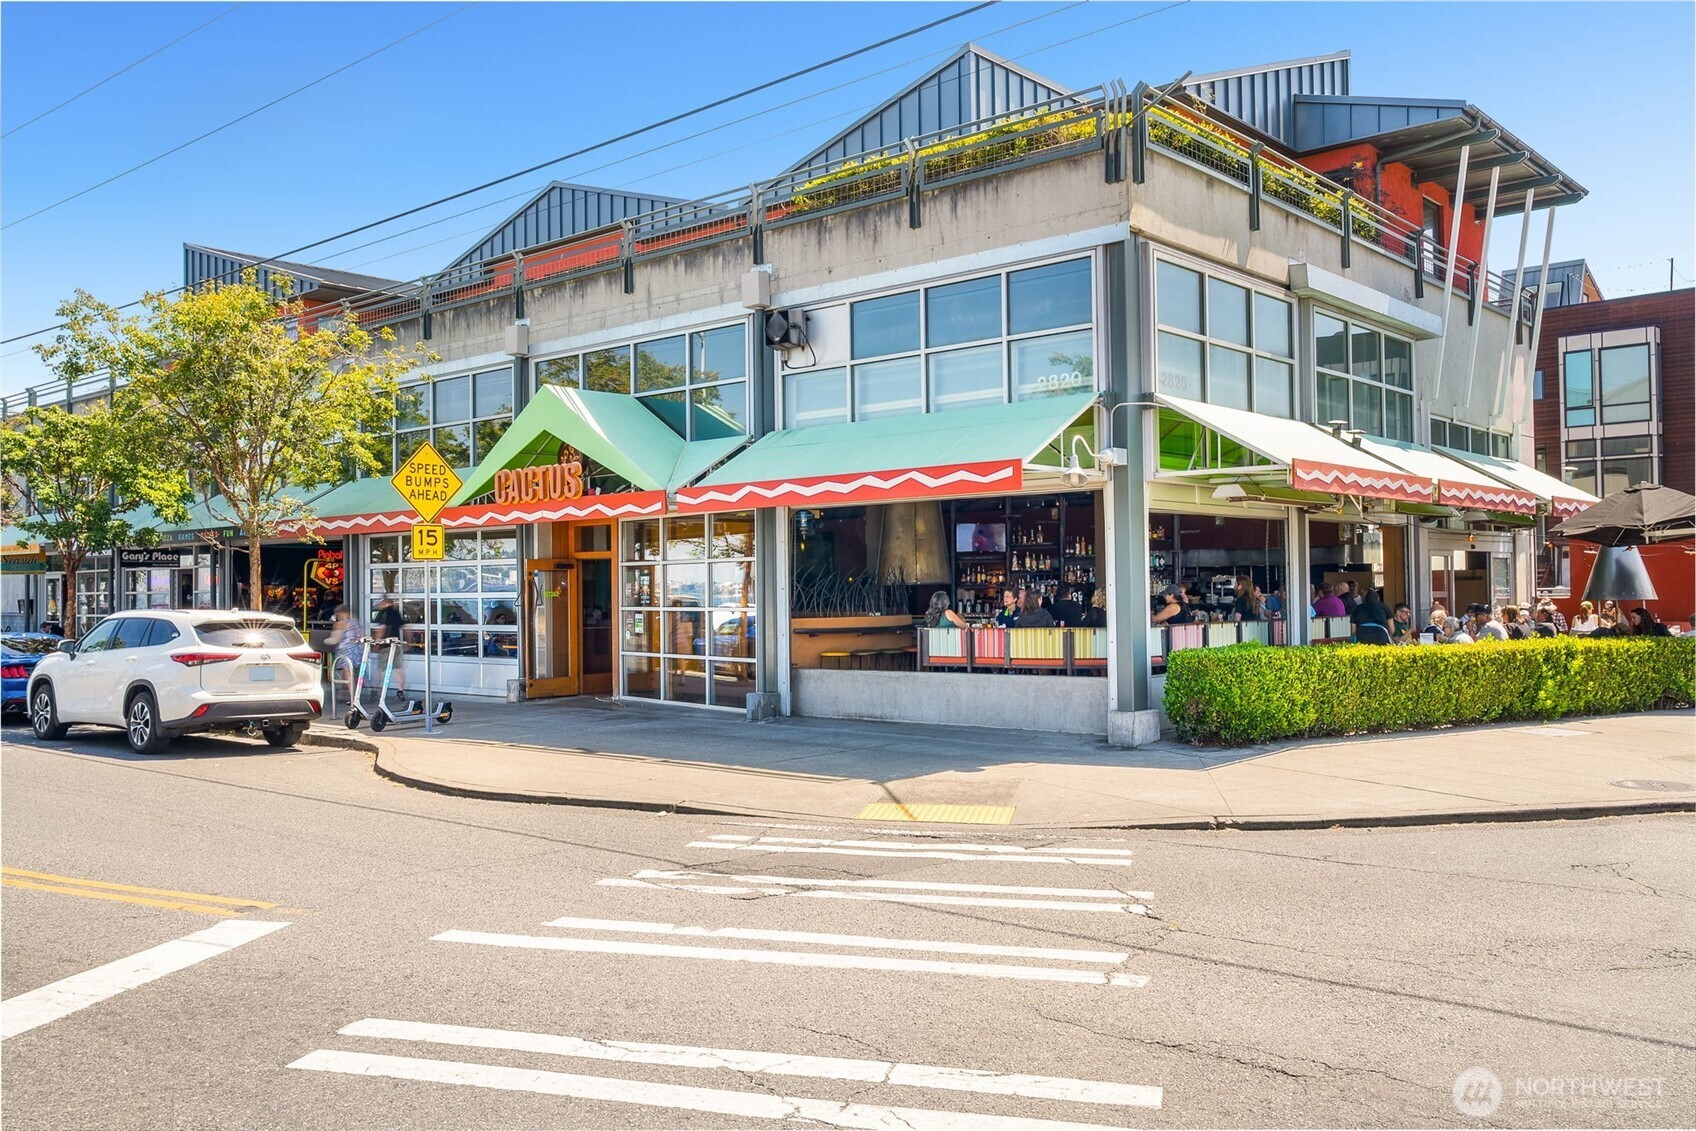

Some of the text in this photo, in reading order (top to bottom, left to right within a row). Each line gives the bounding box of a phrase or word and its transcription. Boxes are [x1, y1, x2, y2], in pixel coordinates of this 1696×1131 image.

[1037, 371, 1082, 390] 2820
[1161, 372, 1188, 390] 2820
[409, 462, 446, 476] SPEED
[405, 475, 449, 489] BUMPS
[494, 461, 582, 505] CACTUS
[409, 489, 447, 501] AHEAD
[178, 532, 195, 540] GAMES
[223, 529, 234, 538] FUN
[418, 529, 438, 546] 15
[2, 554, 40, 566] Seaside
[121, 551, 150, 563] Gary's
[151, 552, 179, 560] Place
[317, 549, 345, 560] Pinbal
[324, 577, 339, 585] VS
